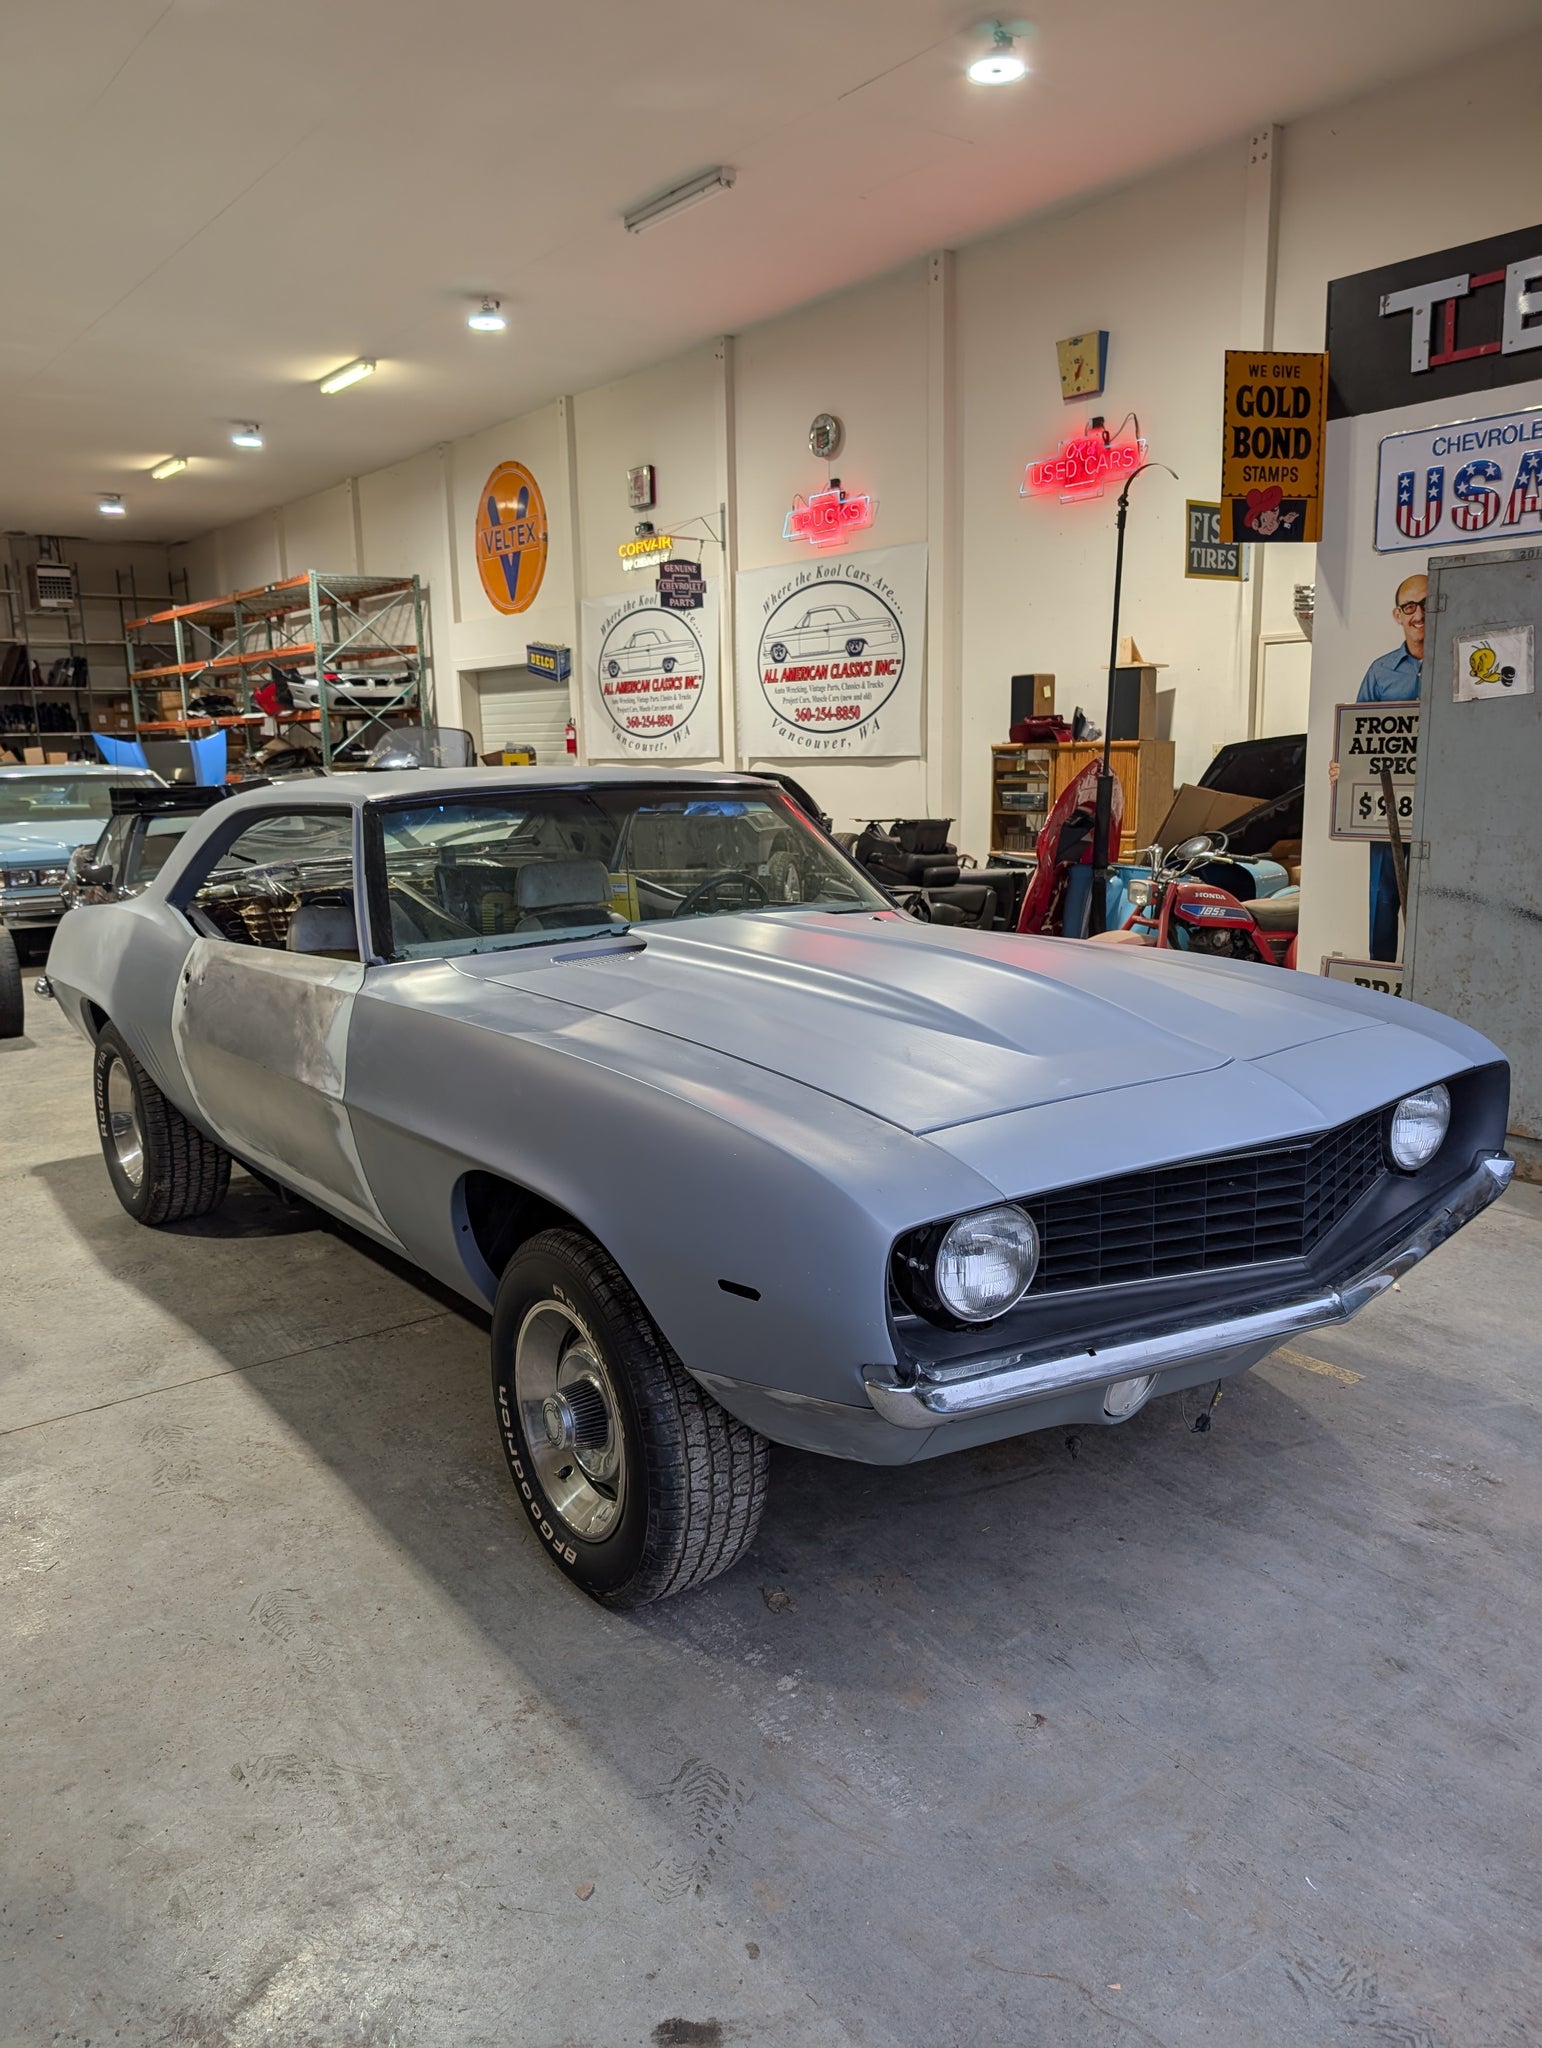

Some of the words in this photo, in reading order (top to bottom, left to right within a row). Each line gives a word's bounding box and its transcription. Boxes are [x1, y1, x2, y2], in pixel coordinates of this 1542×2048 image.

[1249, 364, 1267, 377] WE
[1272, 365, 1301, 379] GIVE
[1236, 385, 1311, 419] GOLD
[1231, 426, 1312, 460] BOND
[1032, 459, 1077, 485] USED
[1084, 447, 1135, 475] CARS
[1243, 465, 1299, 483] STAMPS
[1396, 449, 1542, 538] USA
[791, 503, 859, 529] TRUCKS
[483, 521, 536, 555] VELTEX
[1190, 511, 1238, 545] FIS
[618, 536, 672, 558] CORVAIR
[1190, 547, 1237, 570] TIRES
[664, 565, 698, 574] GENUINE
[661, 579, 701, 591] CHEVROLET
[763, 582, 792, 614] Where
[795, 571, 812, 586] the
[816, 563, 842, 579] Kool
[845, 564, 871, 583] Cars
[599, 608, 621, 636] Where
[623, 600, 636, 613] the
[638, 594, 658, 607] Kool
[669, 599, 695, 608] PARTS
[530, 652, 555, 670] DELCO
[764, 668, 779, 684] ALL
[780, 664, 829, 683] AMERICAN
[830, 660, 873, 679] CLASSICS
[604, 682, 614, 696] ALL
[615, 680, 650, 695] AMERICAN
[652, 677, 683, 692] CLASSICS
[867, 680, 884, 689] Trucks
[795, 705, 861, 722] 360-254-8850
[673, 725, 690, 744] WA
[771, 718, 851, 749] Vancouver,
[859, 717, 880, 740] WA
[1194, 892, 1226, 900] HONDA
[98, 1051, 107, 1069] T/A
[97, 1074, 109, 1138] Radial
[499, 1385, 577, 1566] BFGoodrich
